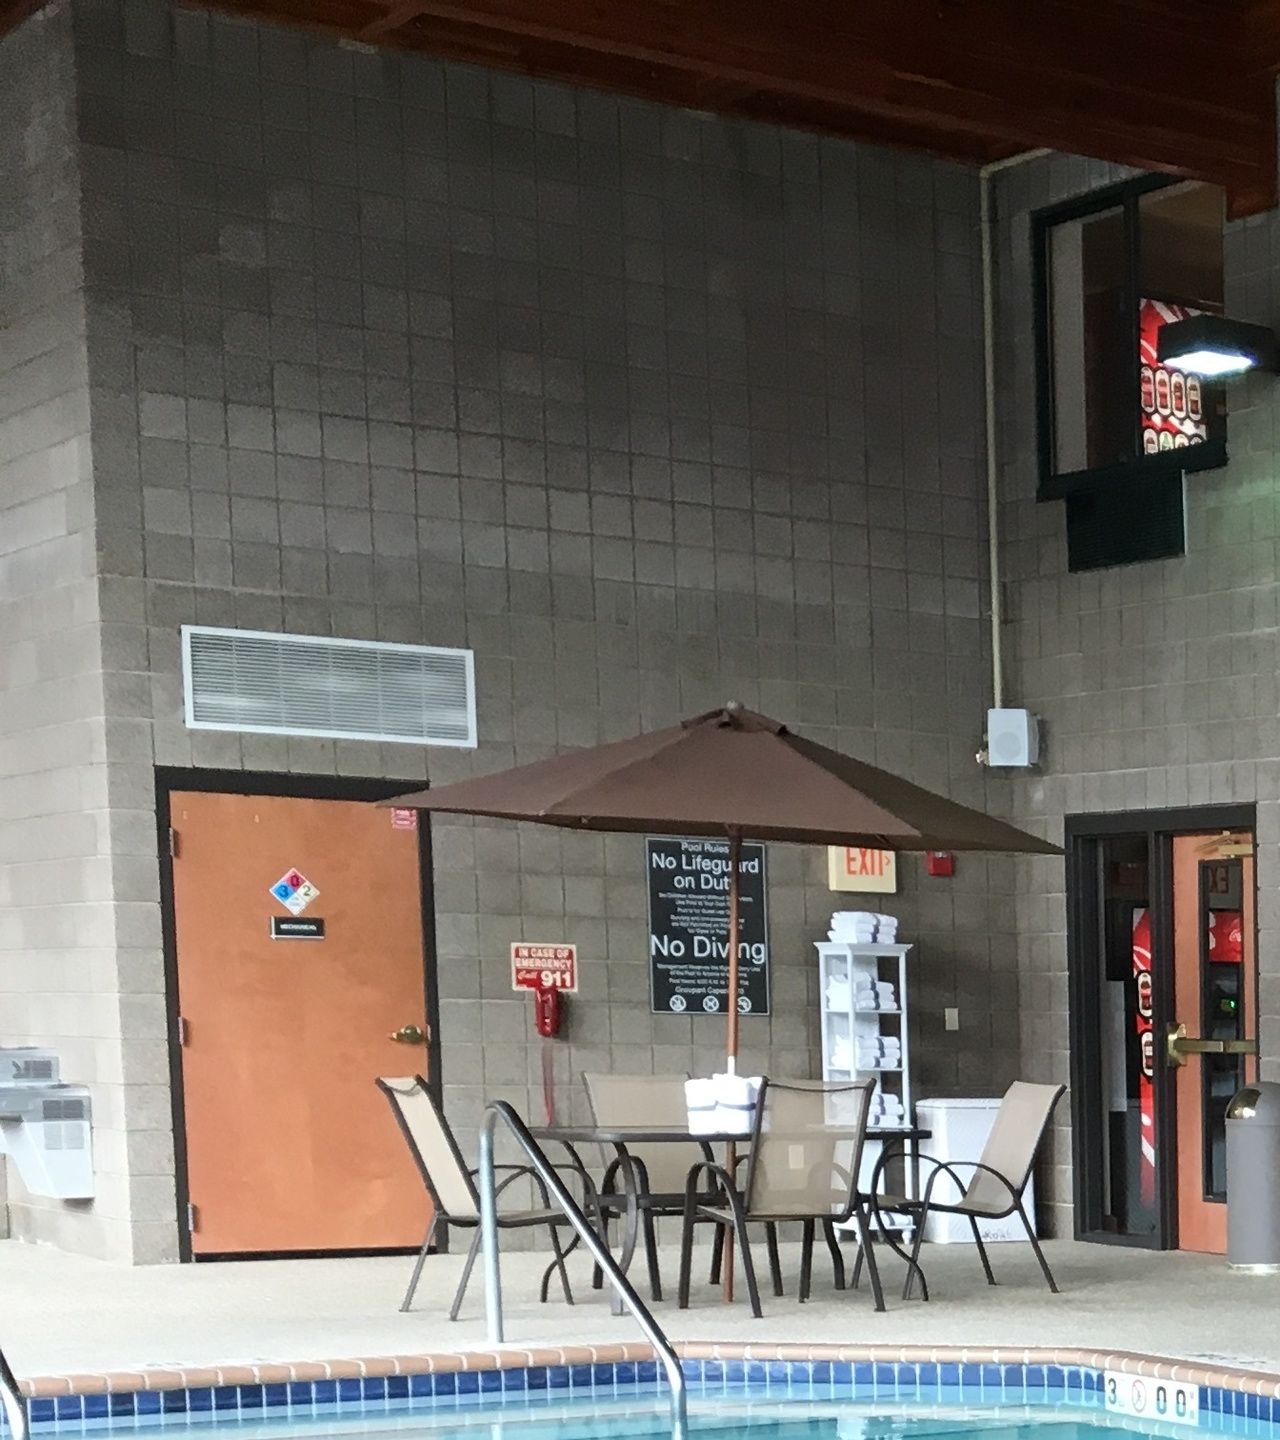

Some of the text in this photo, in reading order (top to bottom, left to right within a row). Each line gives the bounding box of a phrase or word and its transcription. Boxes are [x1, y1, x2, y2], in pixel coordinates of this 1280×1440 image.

[652, 852, 677, 869] No
[291, 874, 300, 888] 0
[673, 873, 731, 890] on Dut
[279, 884, 289, 898] 3
[303, 884, 312, 897] 2
[530, 948, 555, 958] CASE
[651, 934, 765, 964] No Divng
[515, 957, 572, 970] EMERGENCY
[541, 970, 572, 987] 911
